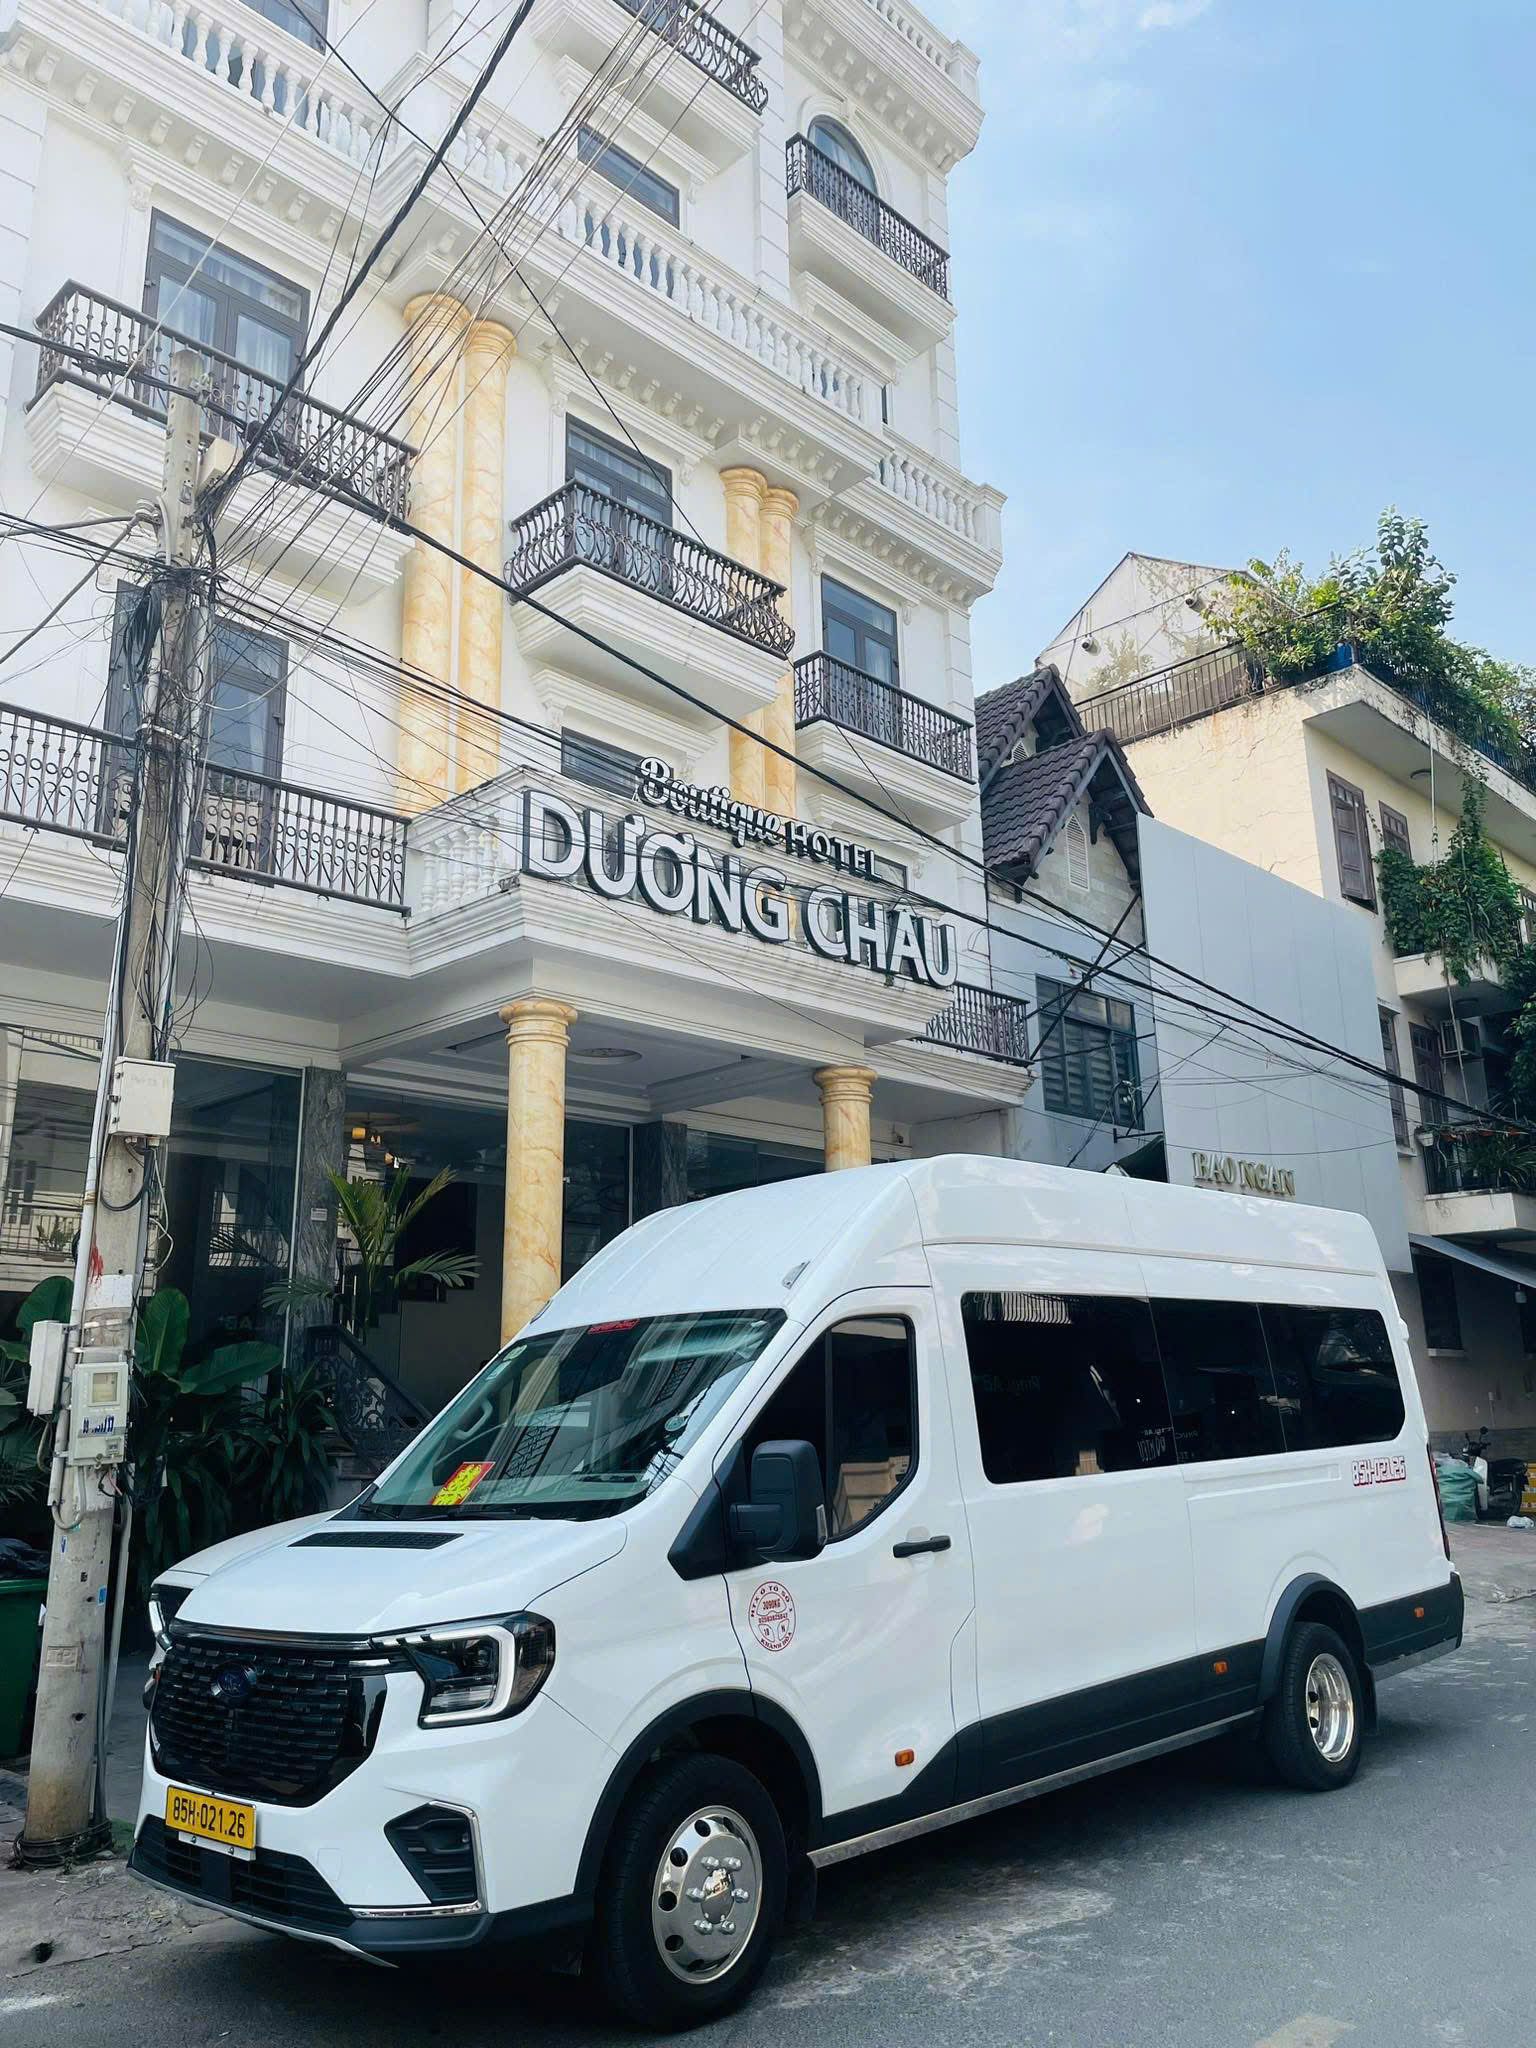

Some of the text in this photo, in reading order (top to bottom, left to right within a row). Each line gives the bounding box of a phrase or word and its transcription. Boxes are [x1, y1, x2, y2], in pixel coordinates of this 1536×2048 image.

[521, 789, 790, 943] DƯƠNG
[637, 757, 883, 881] Boutique HOTEL
[173, 1796, 246, 1839] 85H-021.26
